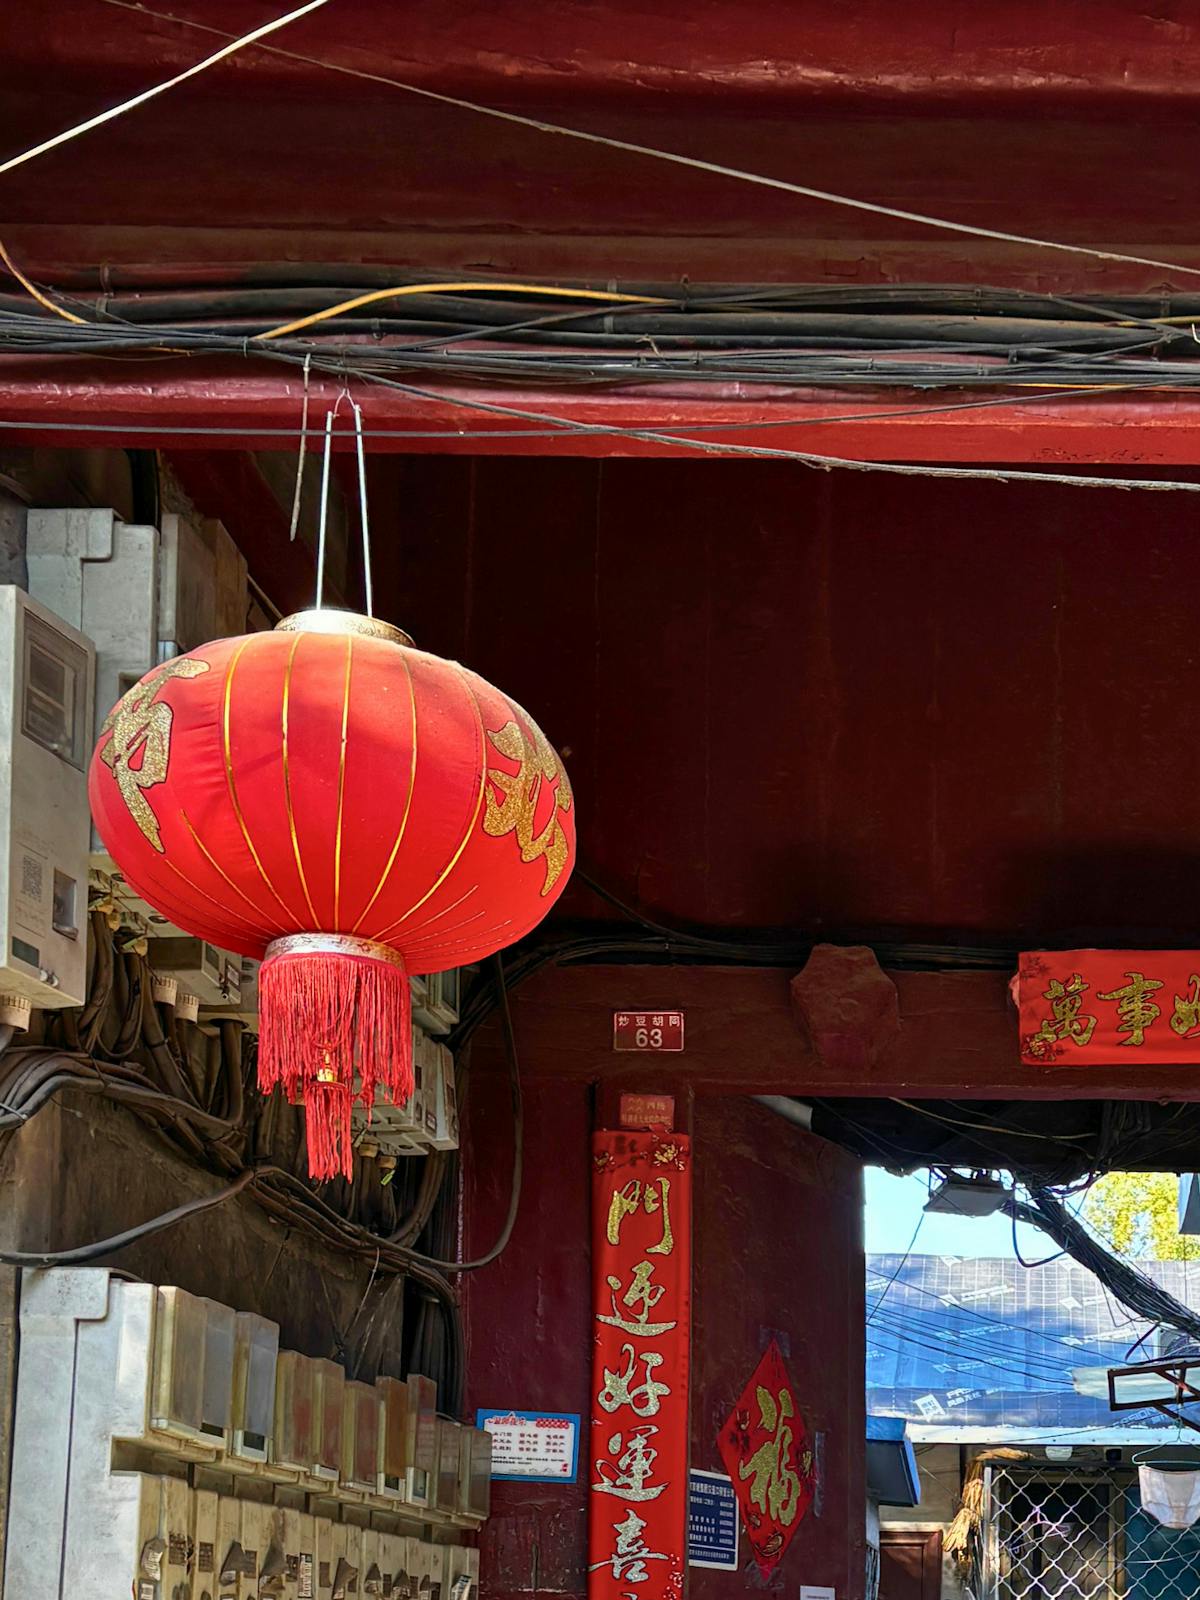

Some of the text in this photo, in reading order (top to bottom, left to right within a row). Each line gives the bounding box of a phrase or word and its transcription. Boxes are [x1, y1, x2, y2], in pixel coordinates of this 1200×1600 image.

[618, 1015, 681, 1027] 炒豆胡同
[635, 1028, 663, 1048] 63
[738, 1385, 800, 1527] 福
